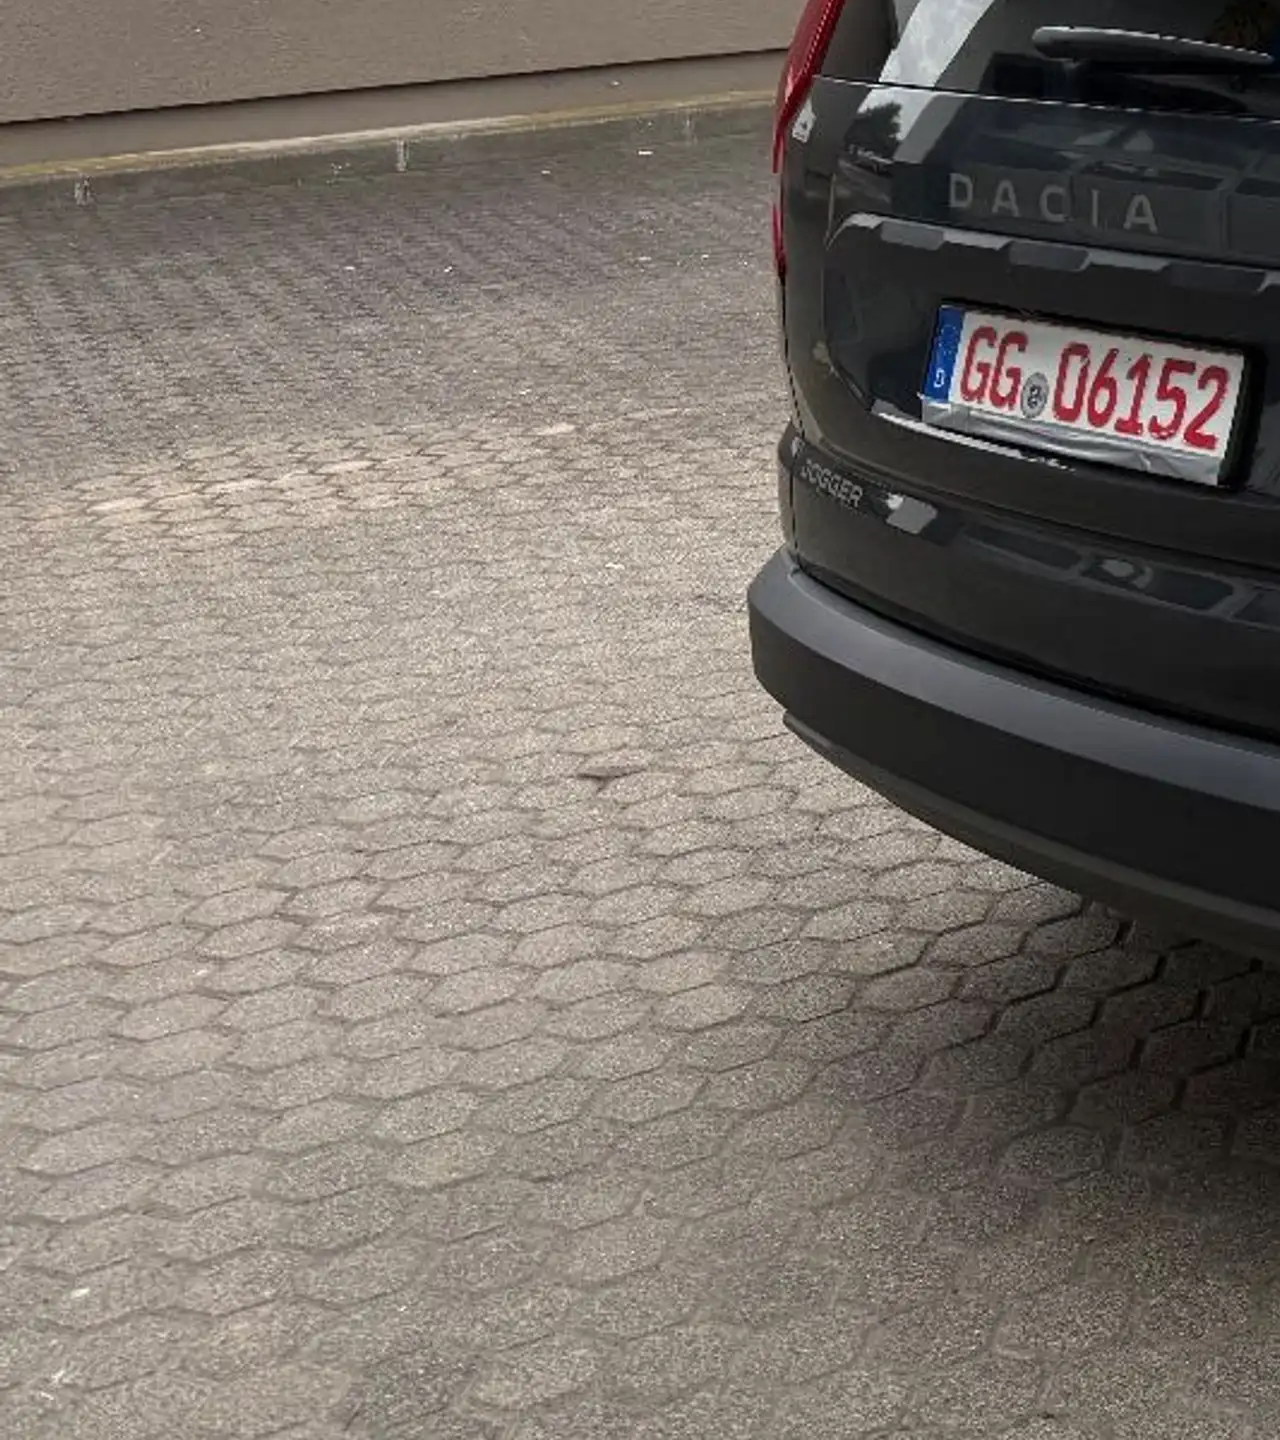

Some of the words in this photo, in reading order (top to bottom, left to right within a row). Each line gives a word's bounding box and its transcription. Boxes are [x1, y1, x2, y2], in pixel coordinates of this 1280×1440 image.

[949, 172, 1159, 234] DACIA
[958, 325, 1029, 411] GG
[1052, 341, 1231, 451] 06152
